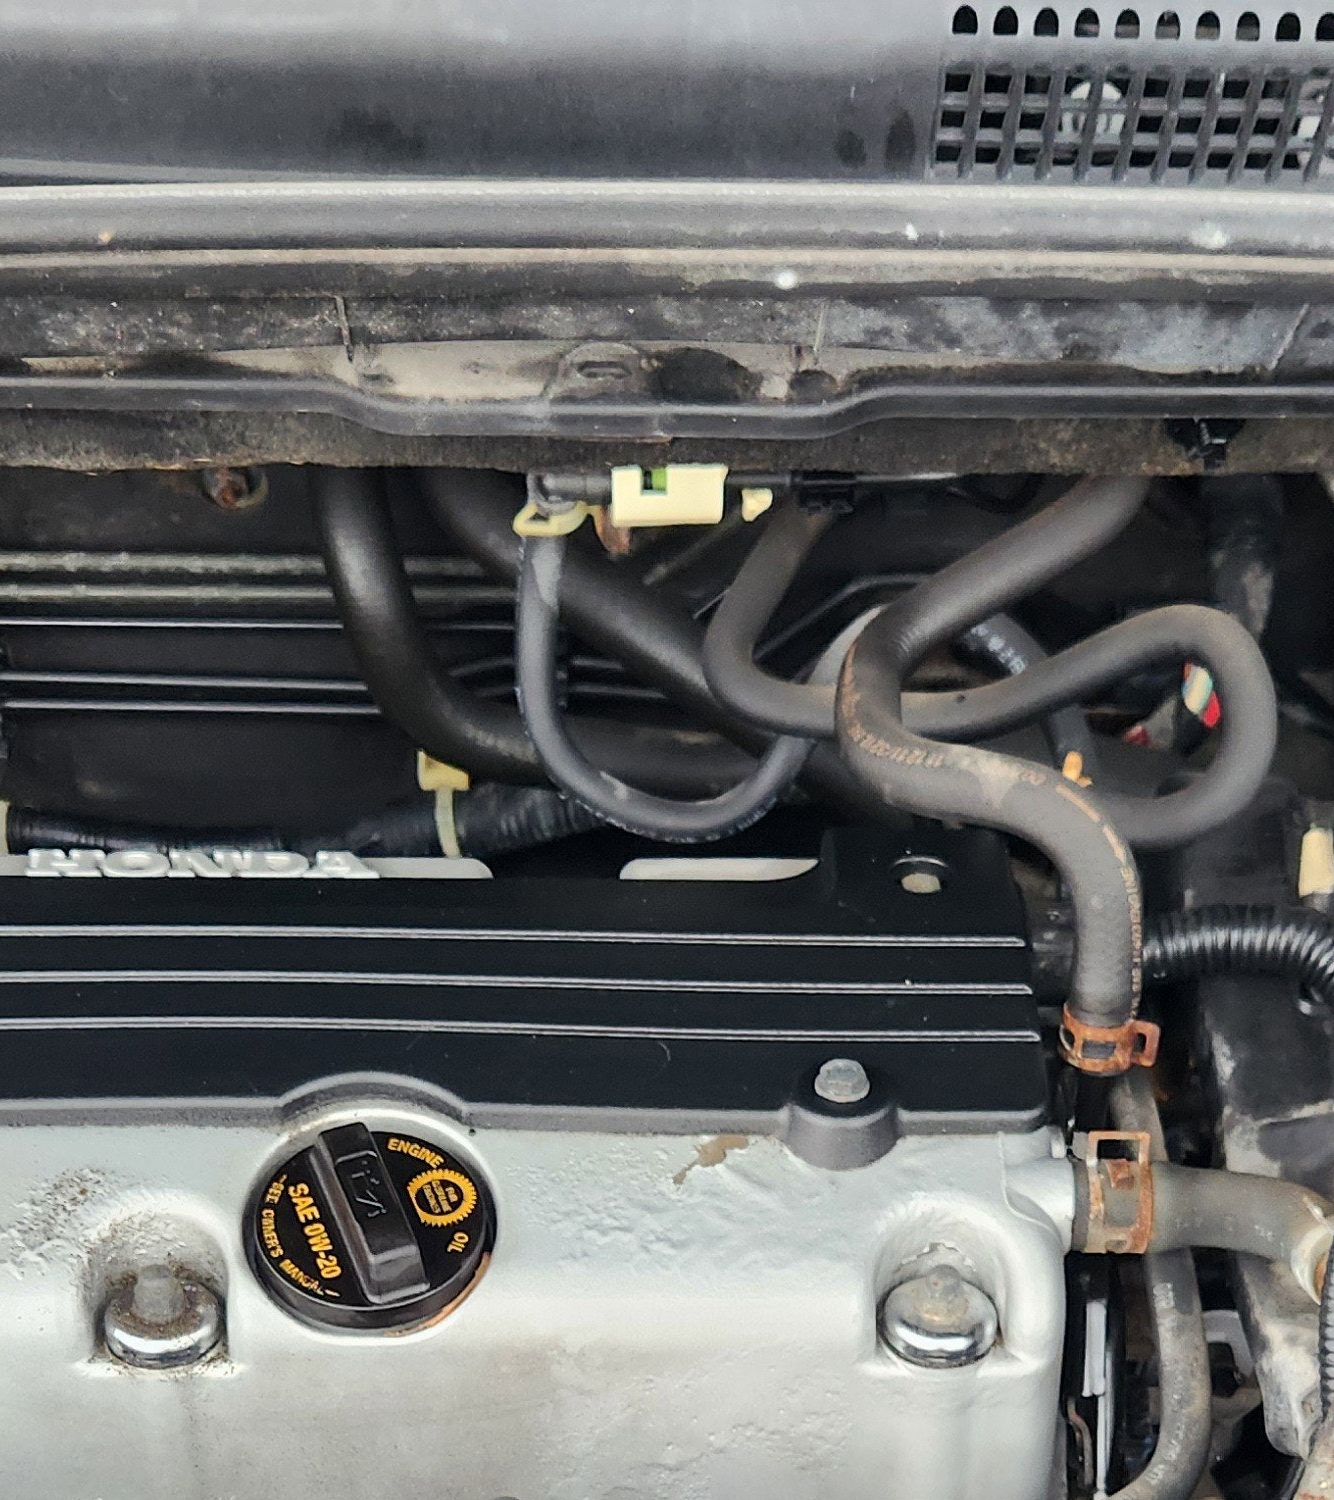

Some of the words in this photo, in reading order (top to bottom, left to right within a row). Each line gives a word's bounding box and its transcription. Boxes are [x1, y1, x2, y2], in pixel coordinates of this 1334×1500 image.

[26, 848, 380, 879] HONDA
[387, 1137, 445, 1169] ENGINE
[288, 1183, 320, 1223] SAE
[304, 1223, 342, 1279] 0W-20
[447, 1231, 469, 1253] OIL
